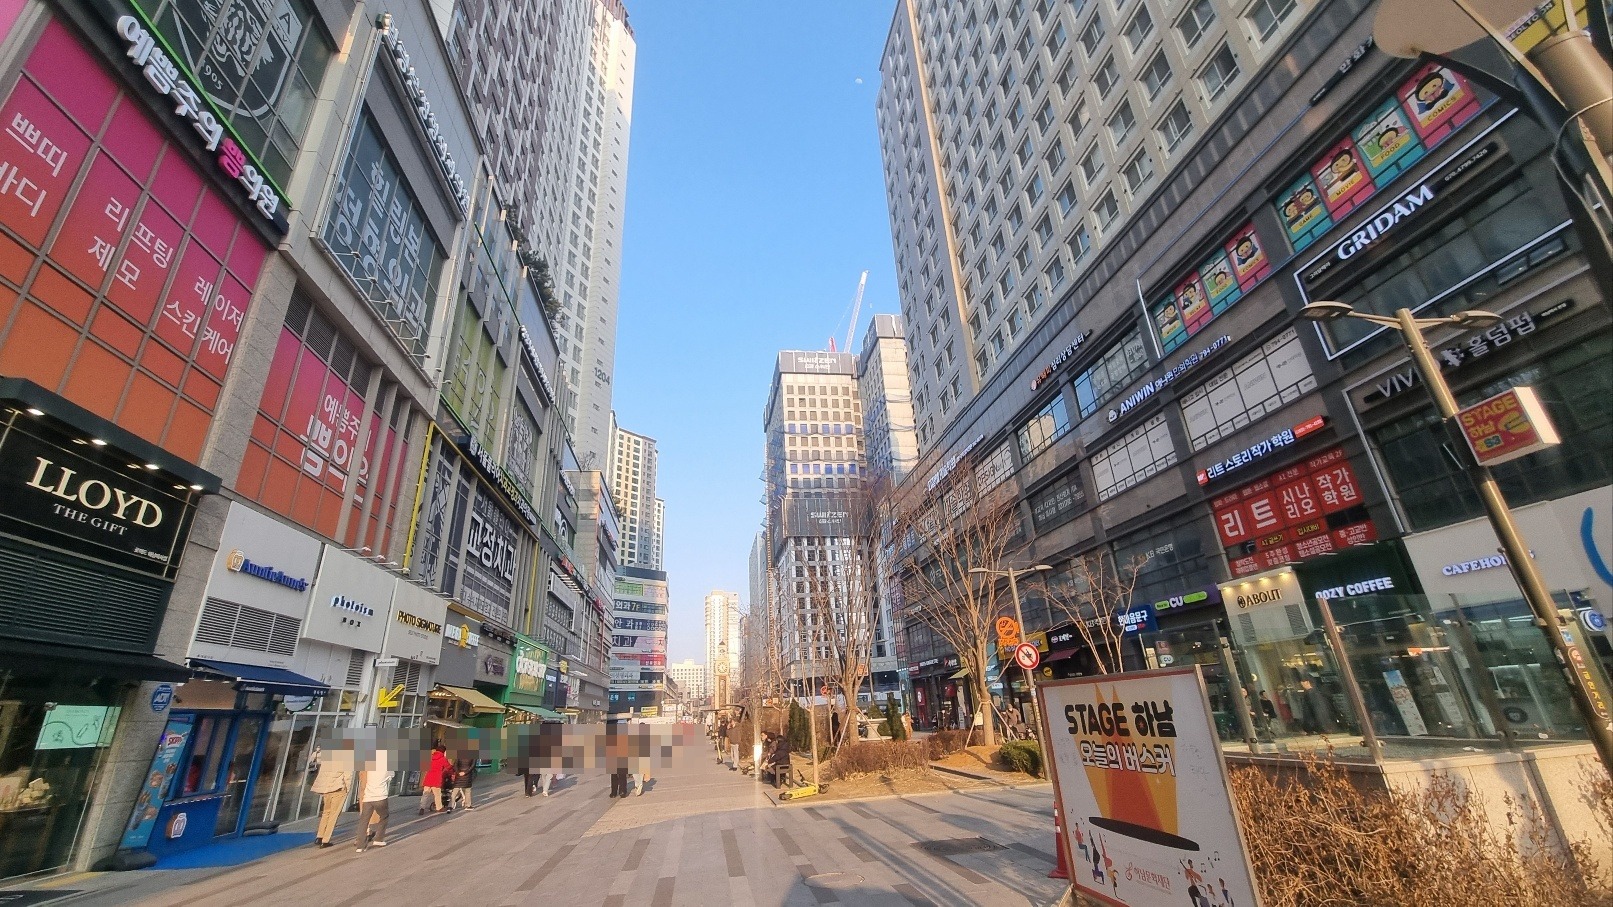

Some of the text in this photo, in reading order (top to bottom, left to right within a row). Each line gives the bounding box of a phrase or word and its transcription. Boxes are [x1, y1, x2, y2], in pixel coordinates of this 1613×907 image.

[5, 112, 68, 178] 쁘띠
[1380, 141, 1401, 160] FOOD
[105, 196, 174, 269] 리프팅
[1337, 184, 1434, 260] GRIDAM
[88, 236, 141, 291] 제모
[194, 276, 243, 329] 레이저
[163, 299, 235, 367] 스킨케어
[1468, 311, 1537, 358] 홀덤펍
[594, 367, 610, 385] 1204
[1119, 381, 1155, 415] ANIWIN
[1461, 395, 1517, 426] STAGE
[25, 456, 163, 529] LLOYD
[1317, 466, 1350, 490] 작가
[1321, 483, 1358, 506] 학원
[53, 503, 128, 536] THE GIFT
[1221, 498, 1278, 538] 리트
[466, 510, 518, 585] 교정치과
[1169, 596, 1184, 608] CU
[1245, 589, 1283, 606] ABOUT
[1345, 577, 1394, 597] COFFEE
[331, 594, 374, 617] photoism
[396, 610, 417, 627] PHOTO
[415, 615, 443, 635] SIGNATURE
[1064, 700, 1178, 738] STAGE 하남
[1079, 739, 1177, 778] 오늘의 버스커
